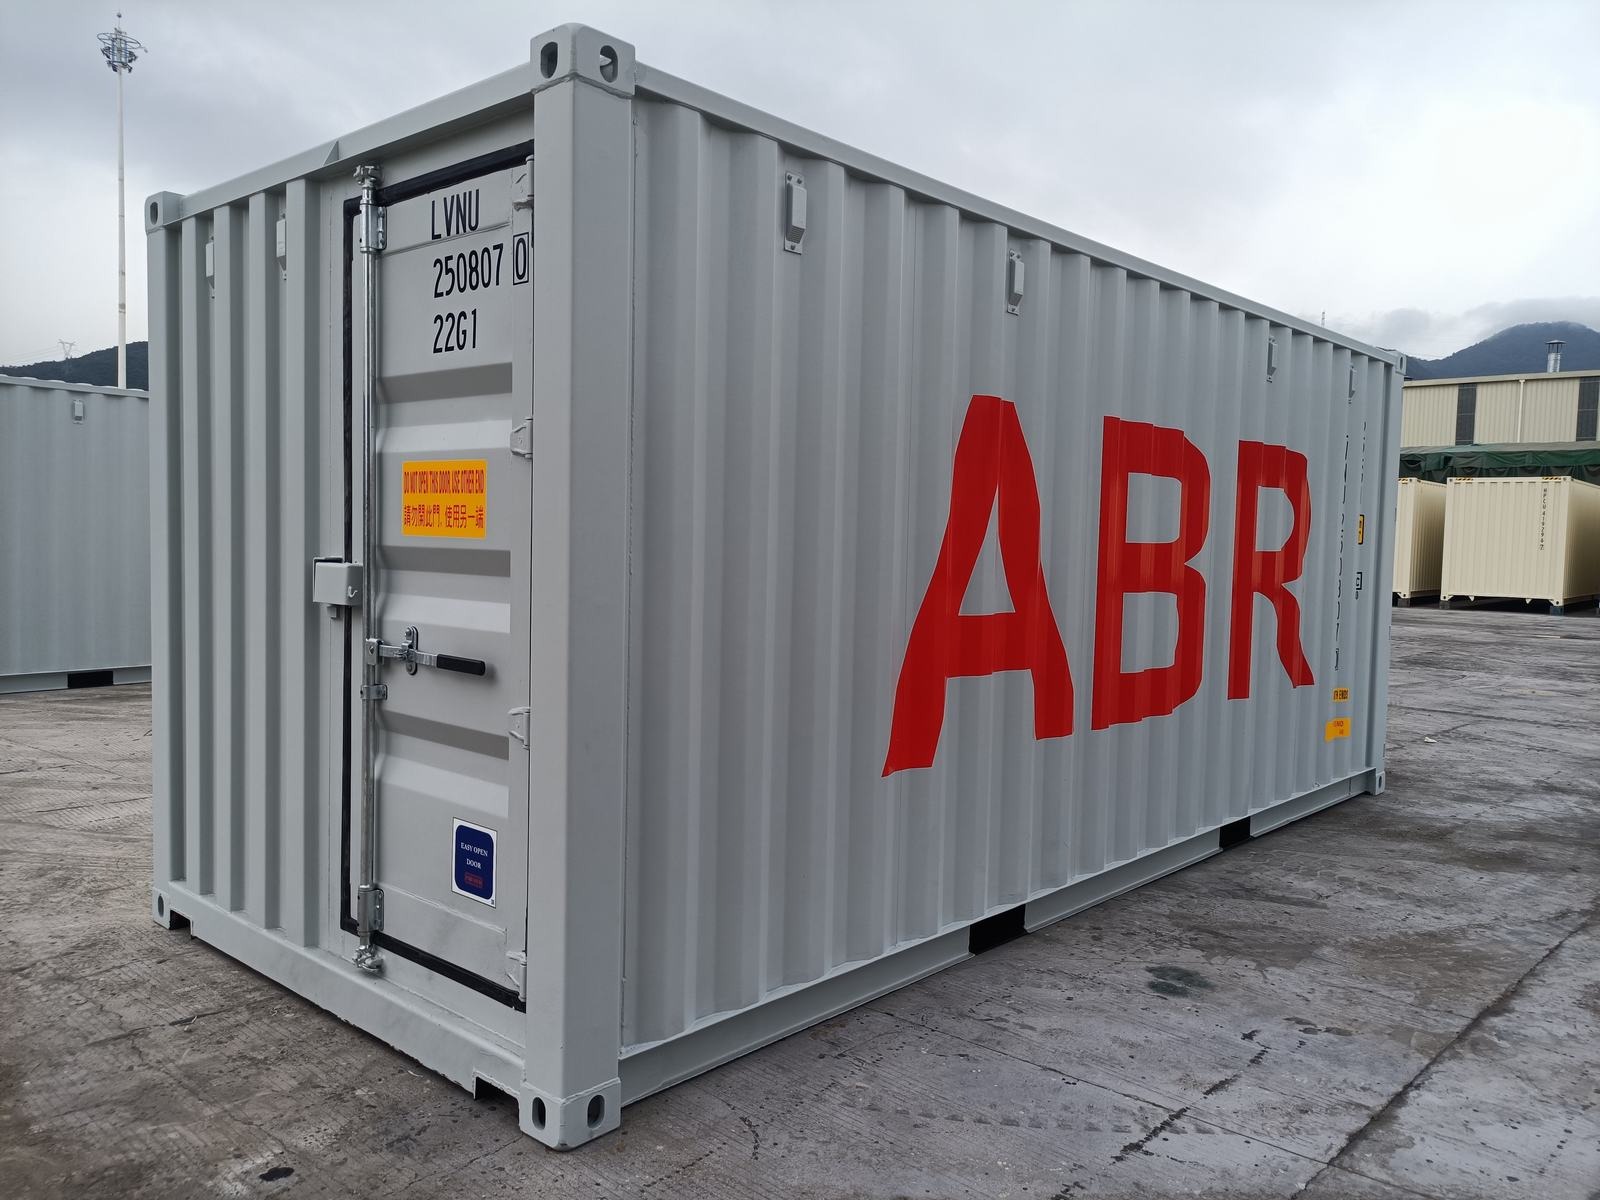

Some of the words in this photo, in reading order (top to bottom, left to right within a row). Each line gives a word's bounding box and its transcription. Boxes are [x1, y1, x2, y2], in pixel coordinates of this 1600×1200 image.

[431, 189, 480, 241] LVNU
[433, 243, 504, 299] 250807
[433, 308, 477, 354] 22G1
[410, 471, 418, 494] NOT
[418, 471, 429, 494] OPEN
[429, 471, 438, 494] THIS
[451, 470, 460, 494] USE
[460, 470, 475, 494] OTHER
[475, 469, 485, 494] END
[881, 394, 1315, 778] ABR
[460, 842, 473, 852] EASY
[473, 846, 488, 857] OPEN
[466, 858, 481, 869] DOOR
